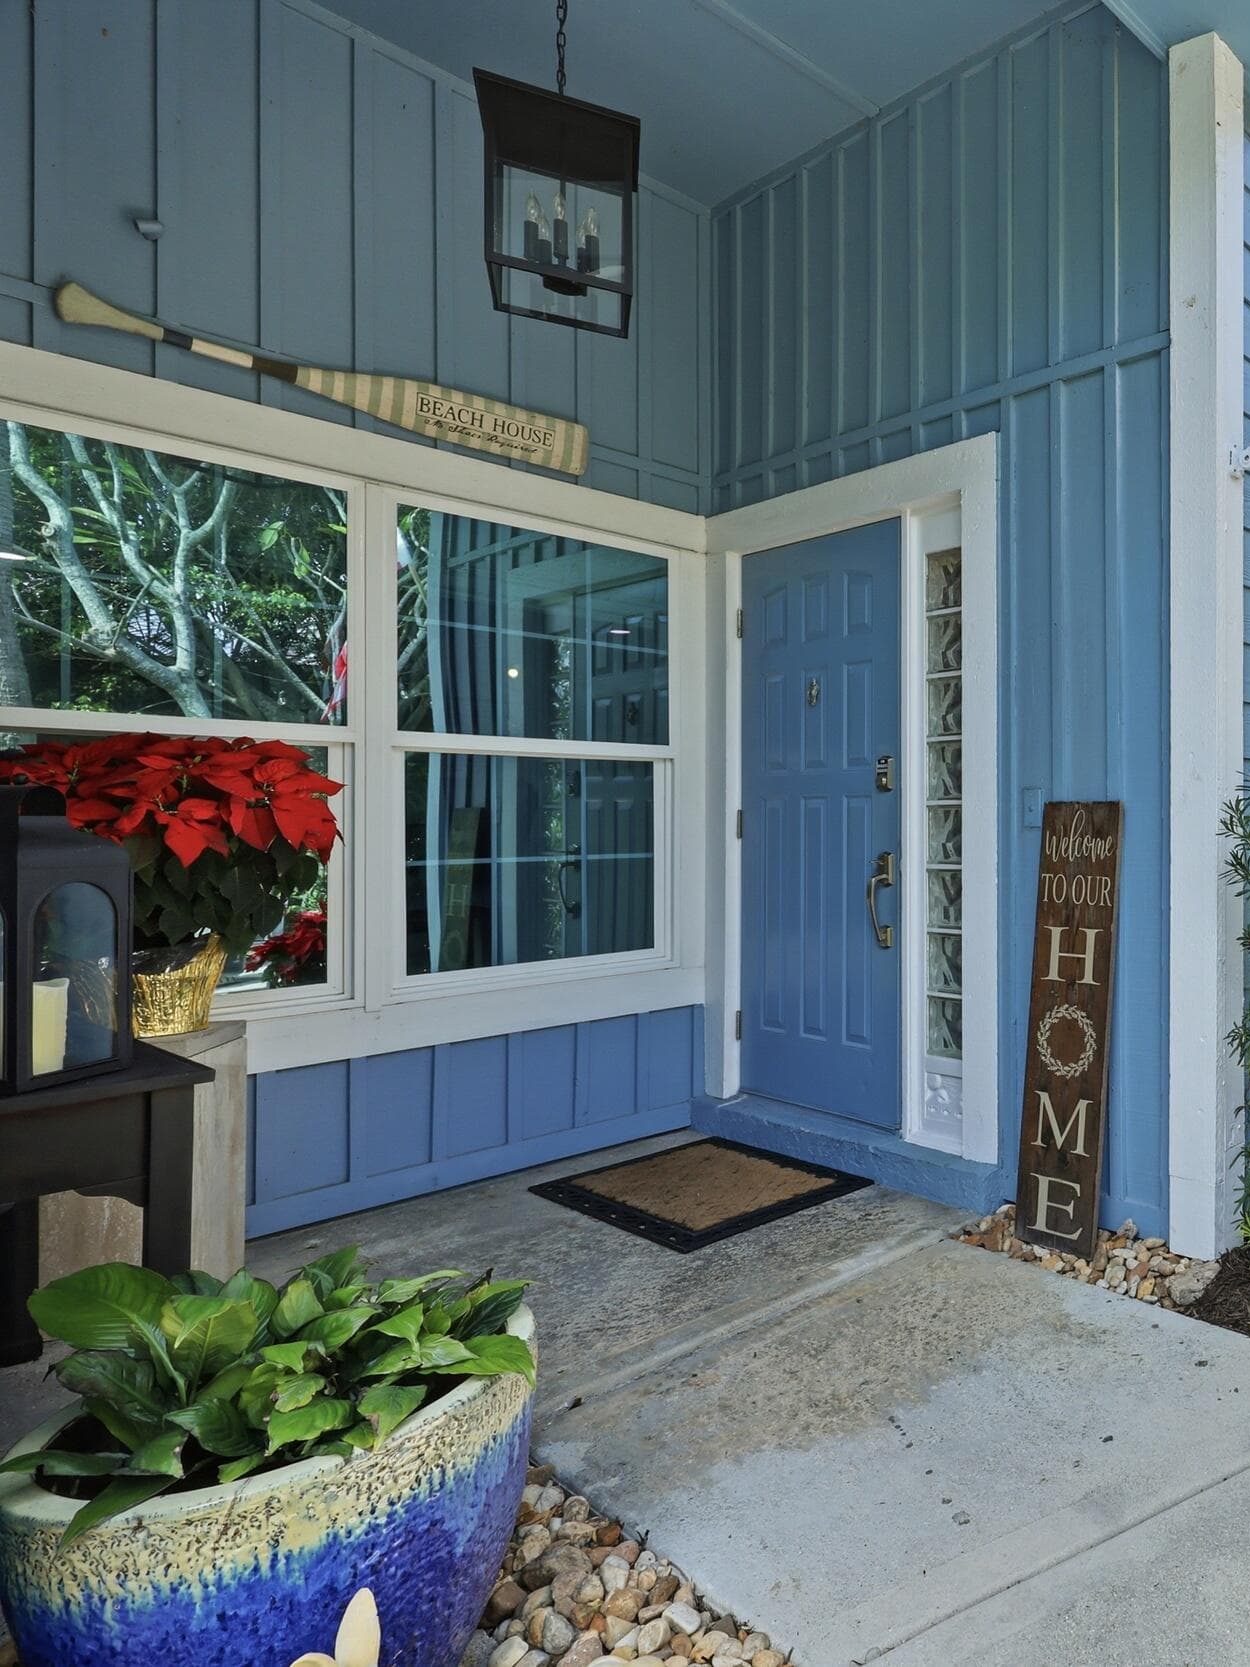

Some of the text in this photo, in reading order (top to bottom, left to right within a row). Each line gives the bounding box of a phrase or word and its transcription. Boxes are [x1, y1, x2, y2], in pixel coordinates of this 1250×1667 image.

[418, 396, 553, 448] BEACH HOUSE
[448, 423, 482, 439] Shoes
[486, 432, 538, 454] Required
[1045, 809, 1115, 863] Welcome
[1040, 873, 1112, 907] TO OUR
